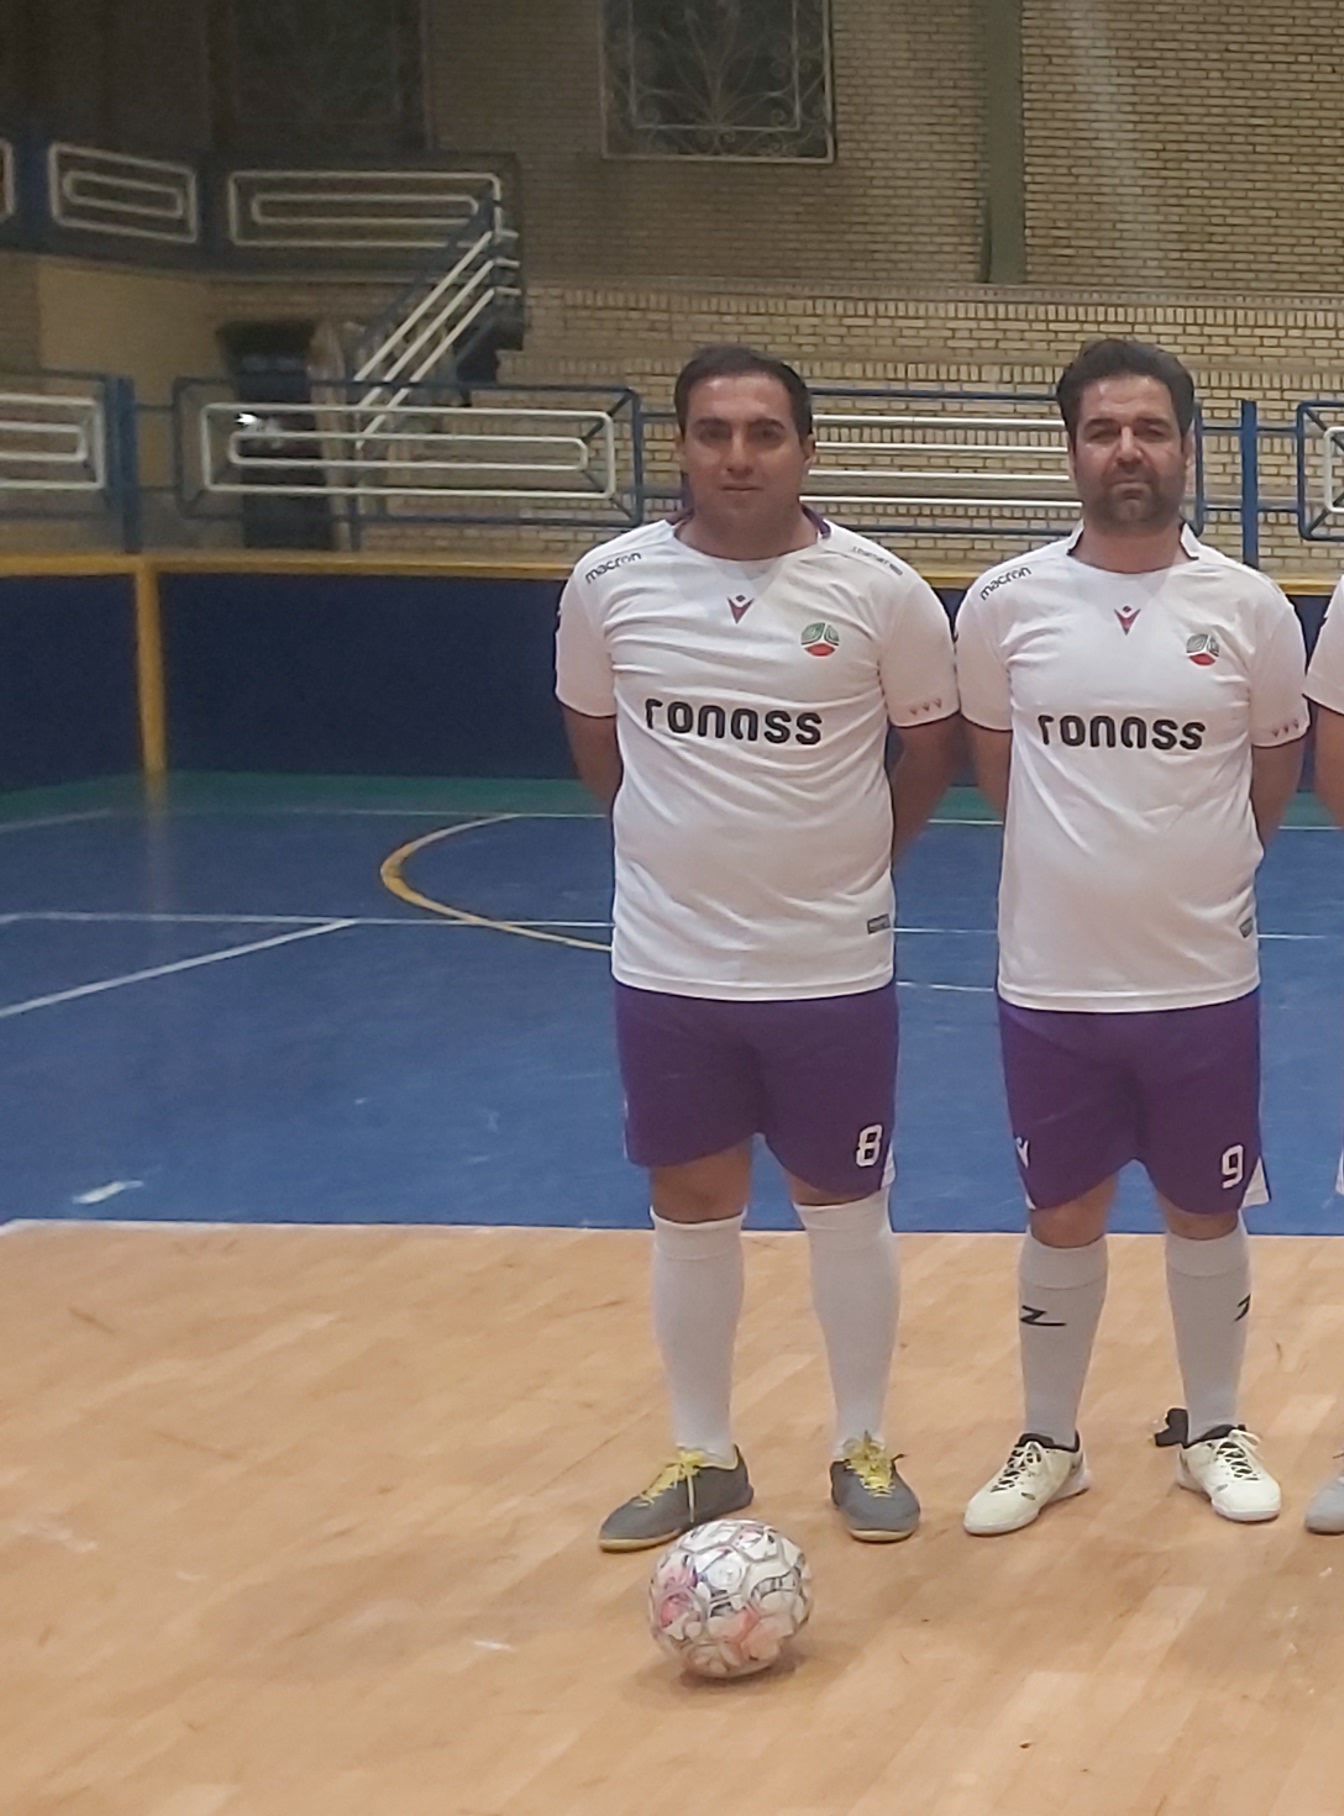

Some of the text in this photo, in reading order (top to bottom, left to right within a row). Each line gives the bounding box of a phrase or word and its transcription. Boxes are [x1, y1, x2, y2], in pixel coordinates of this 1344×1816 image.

[584, 551, 642, 584] macron
[979, 566, 1032, 601] macron
[645, 698, 823, 745] ronass
[1037, 714, 1206, 750] ronass
[855, 1124, 883, 1167] 8
[1222, 1144, 1244, 1189] 9
